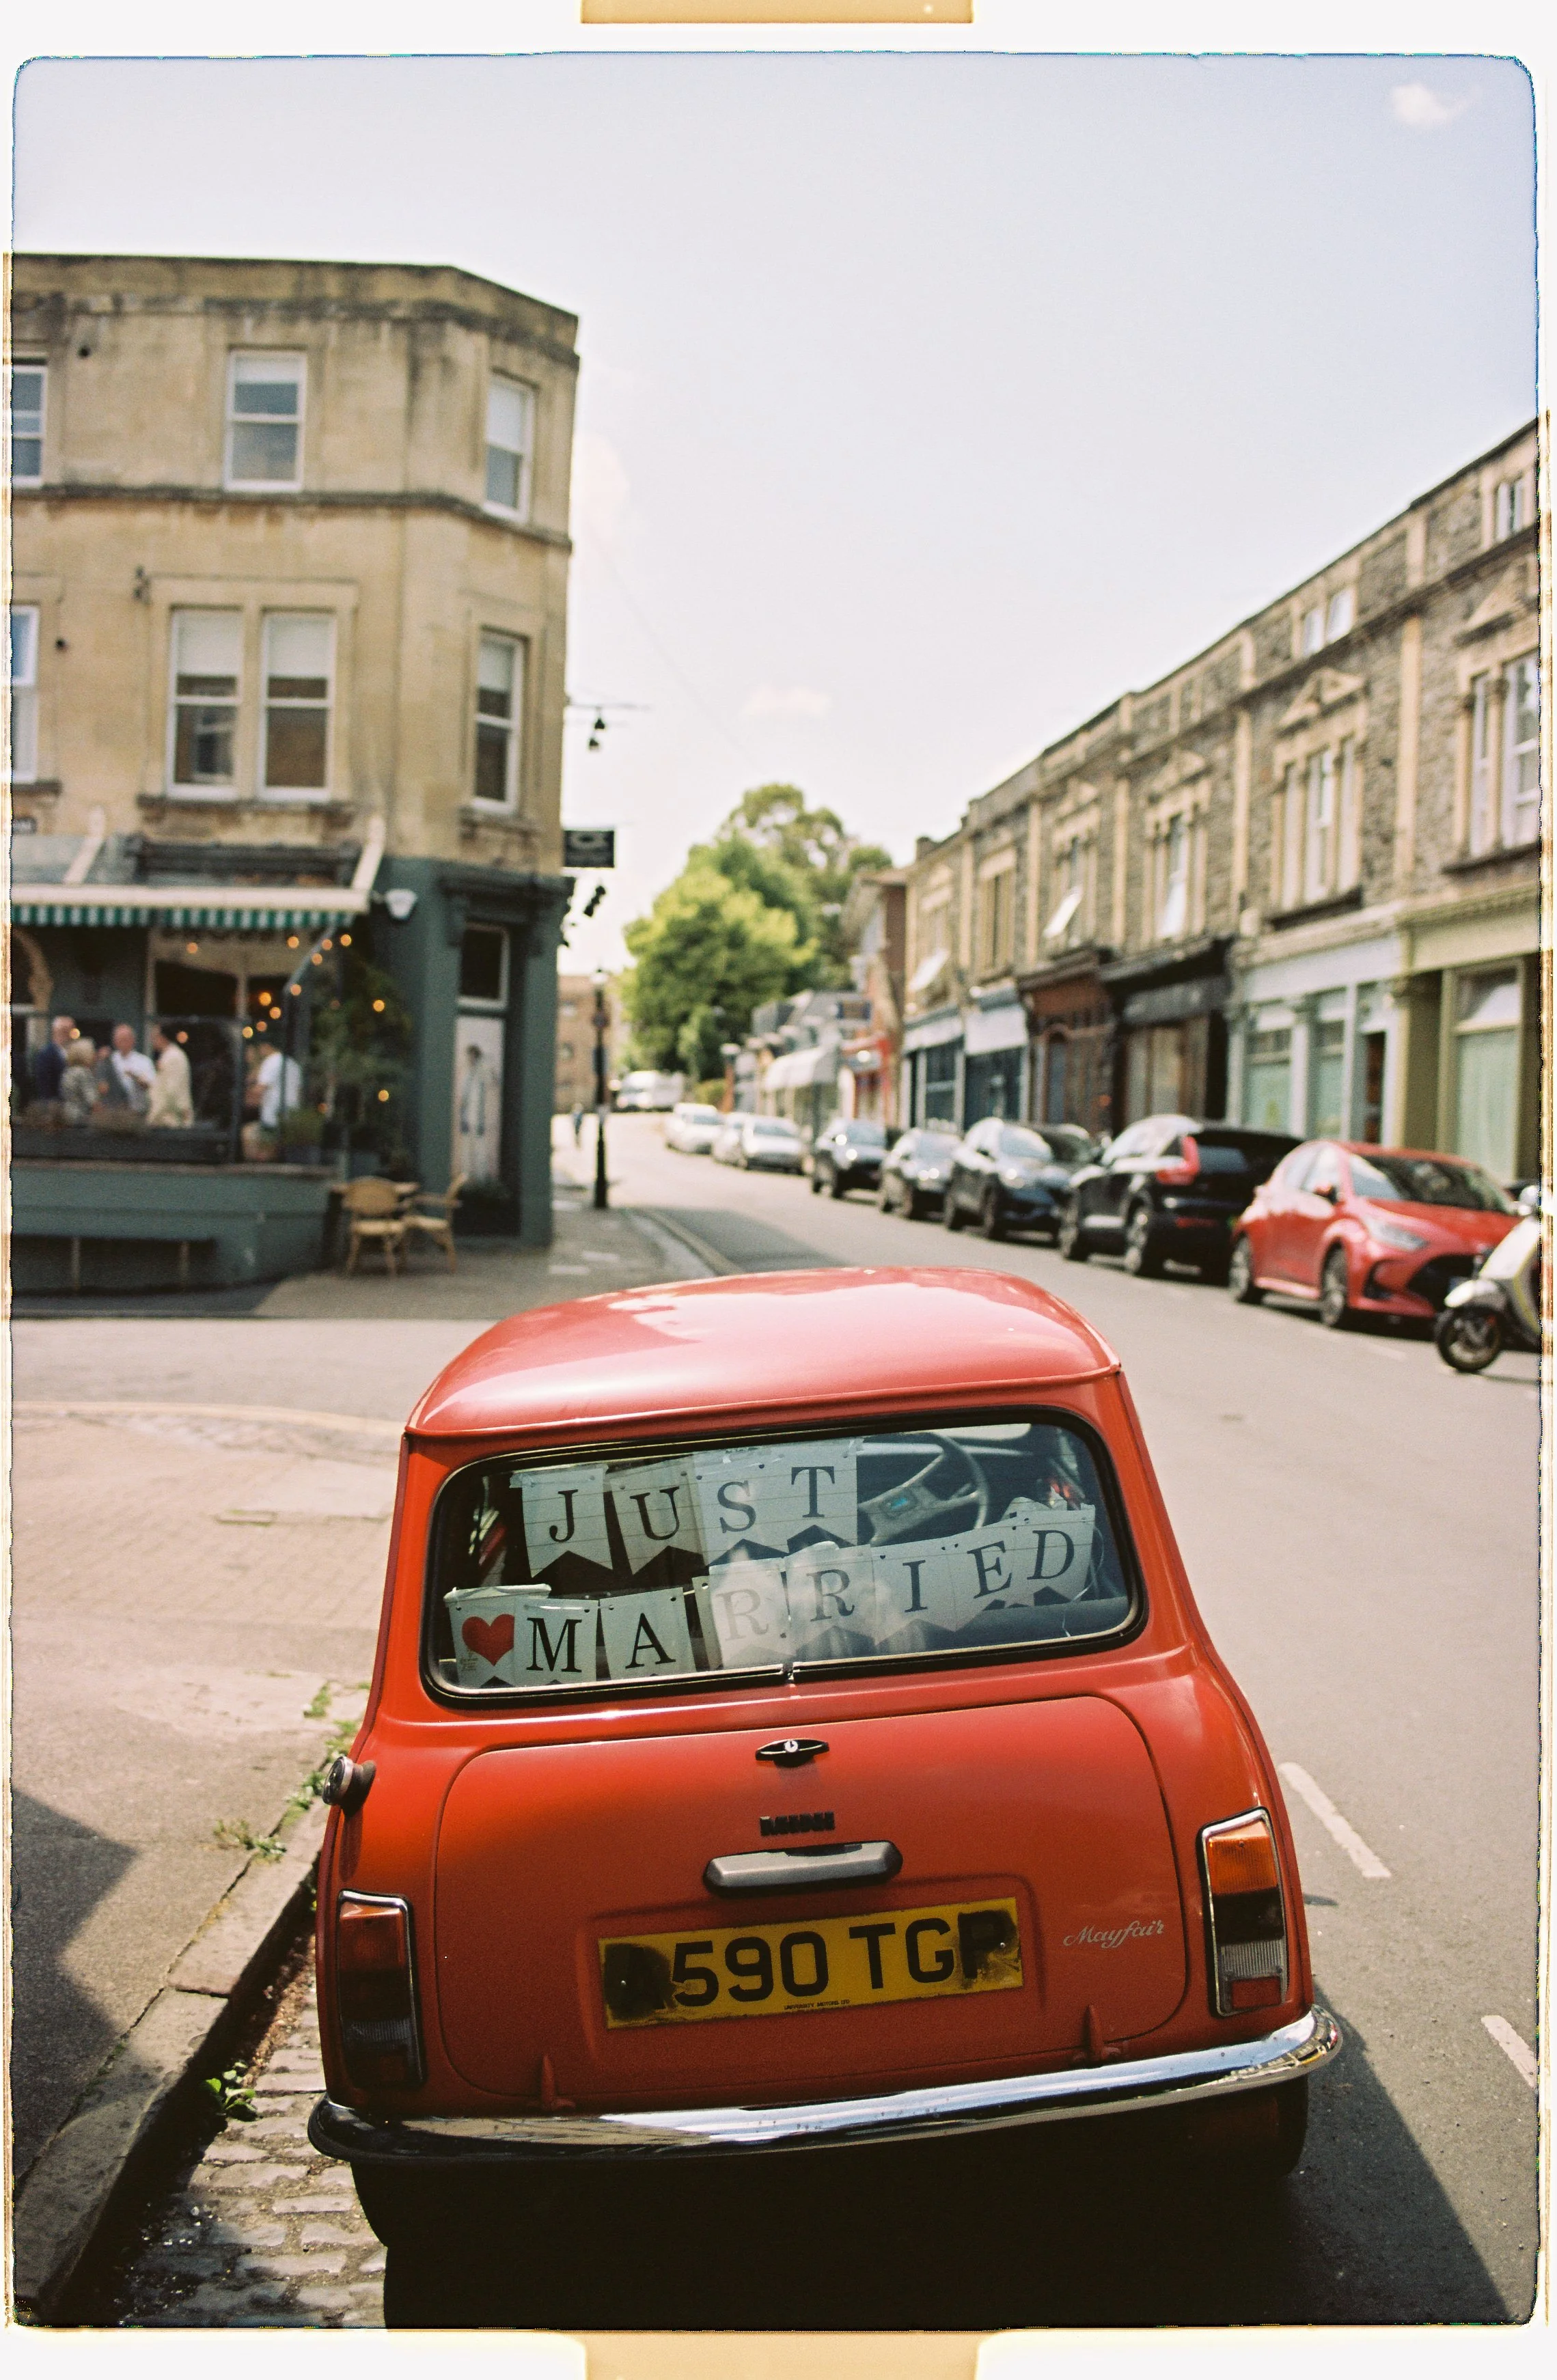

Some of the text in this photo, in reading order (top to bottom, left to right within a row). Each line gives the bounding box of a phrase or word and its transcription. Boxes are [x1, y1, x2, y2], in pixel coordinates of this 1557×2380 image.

[549, 1466, 836, 1543] JUST
[526, 1530, 1076, 1673] MARRIED
[608, 1911, 1008, 2010] 590 TGP
[1063, 1920, 1164, 1948] Mayfair
